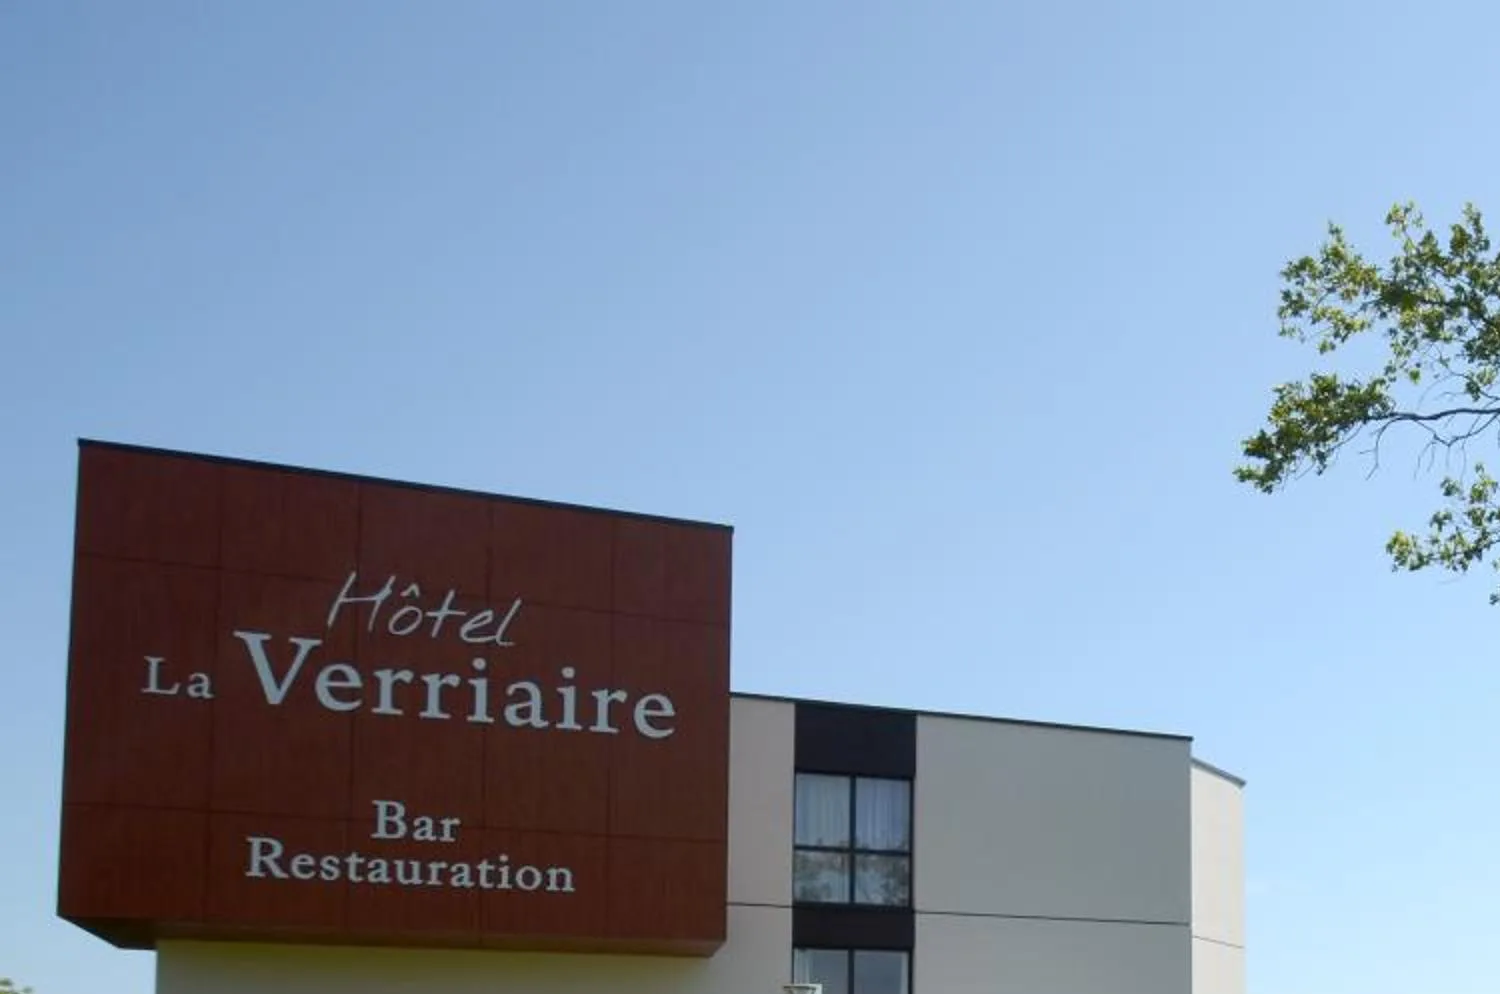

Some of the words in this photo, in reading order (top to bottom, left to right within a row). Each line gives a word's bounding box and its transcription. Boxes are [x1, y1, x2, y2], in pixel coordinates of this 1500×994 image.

[327, 571, 522, 647] Hôtel
[143, 656, 214, 699] La
[233, 630, 676, 739] Verriaire
[371, 799, 461, 843] Bar
[245, 837, 575, 893] Restauration
